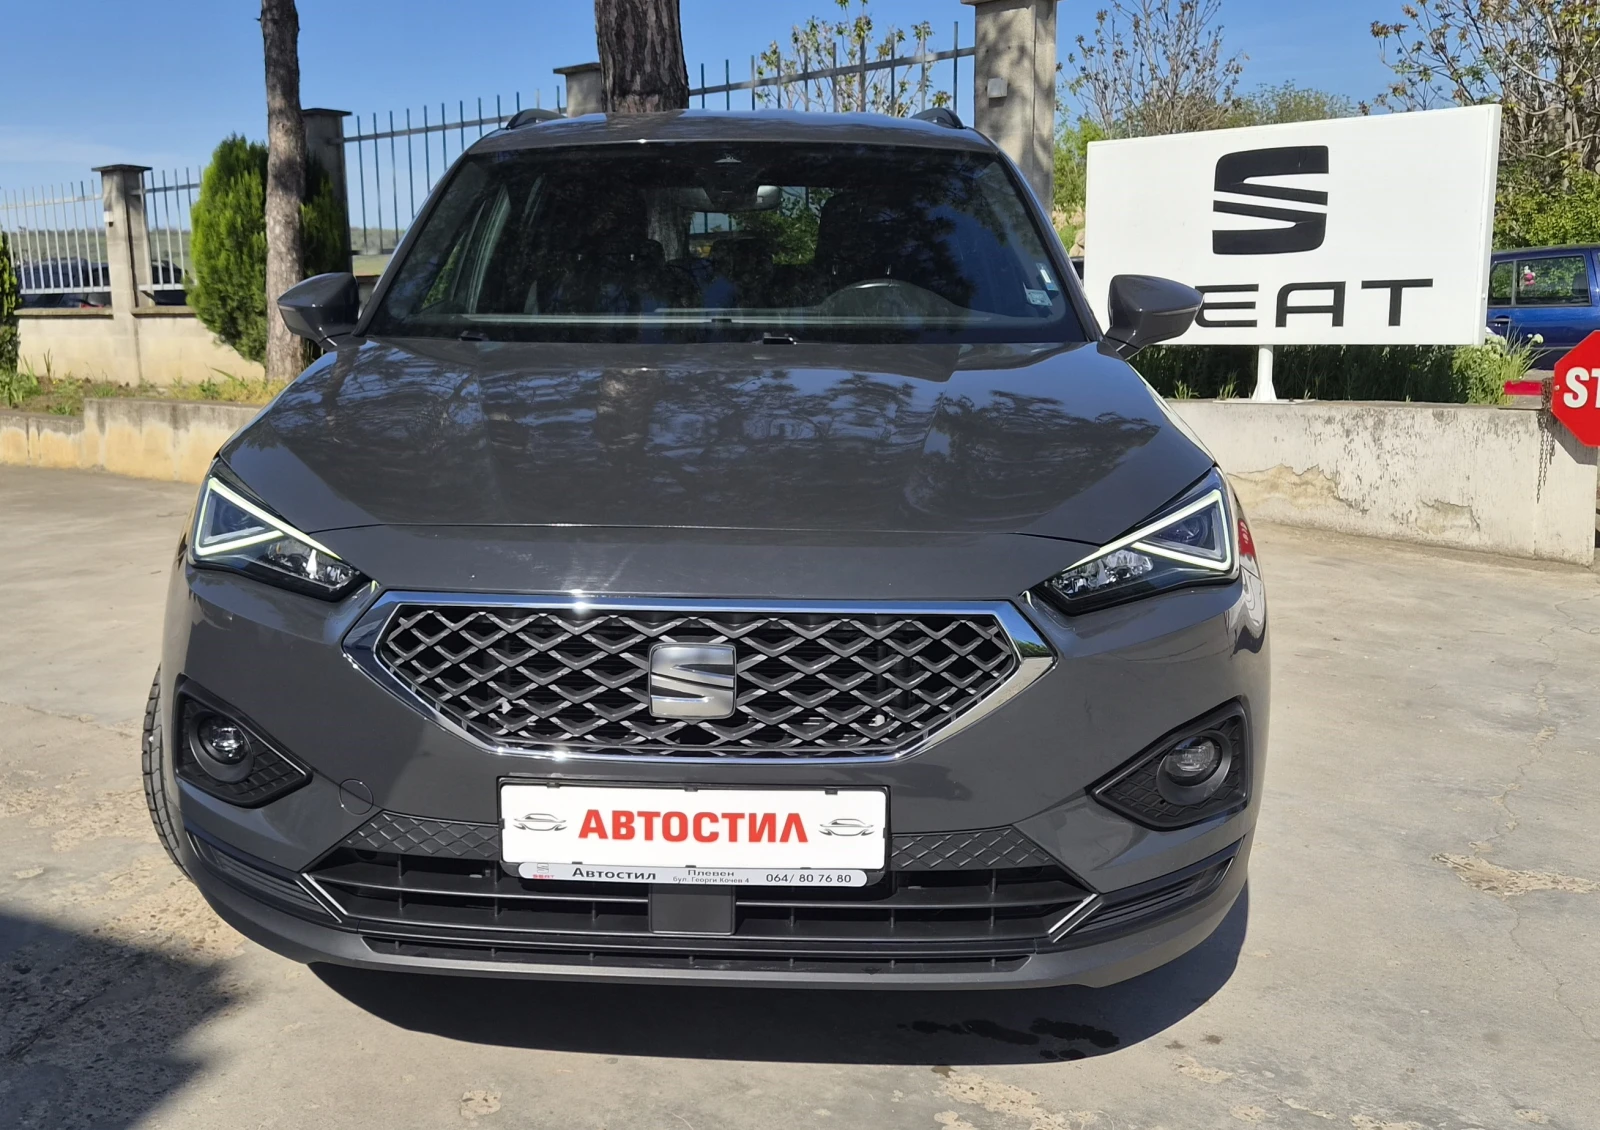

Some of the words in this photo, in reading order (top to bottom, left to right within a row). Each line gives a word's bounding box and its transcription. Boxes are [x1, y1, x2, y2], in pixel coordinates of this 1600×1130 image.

[1193, 278, 1434, 328] EAT
[578, 808, 809, 843] АВТОСТИЛ
[687, 869, 735, 877] Плевен
[766, 873, 794, 884] 064/
[799, 874, 814, 883] 80
[818, 874, 833, 883] 76
[836, 874, 852, 883] 80
[691, 877, 717, 885] Георги
